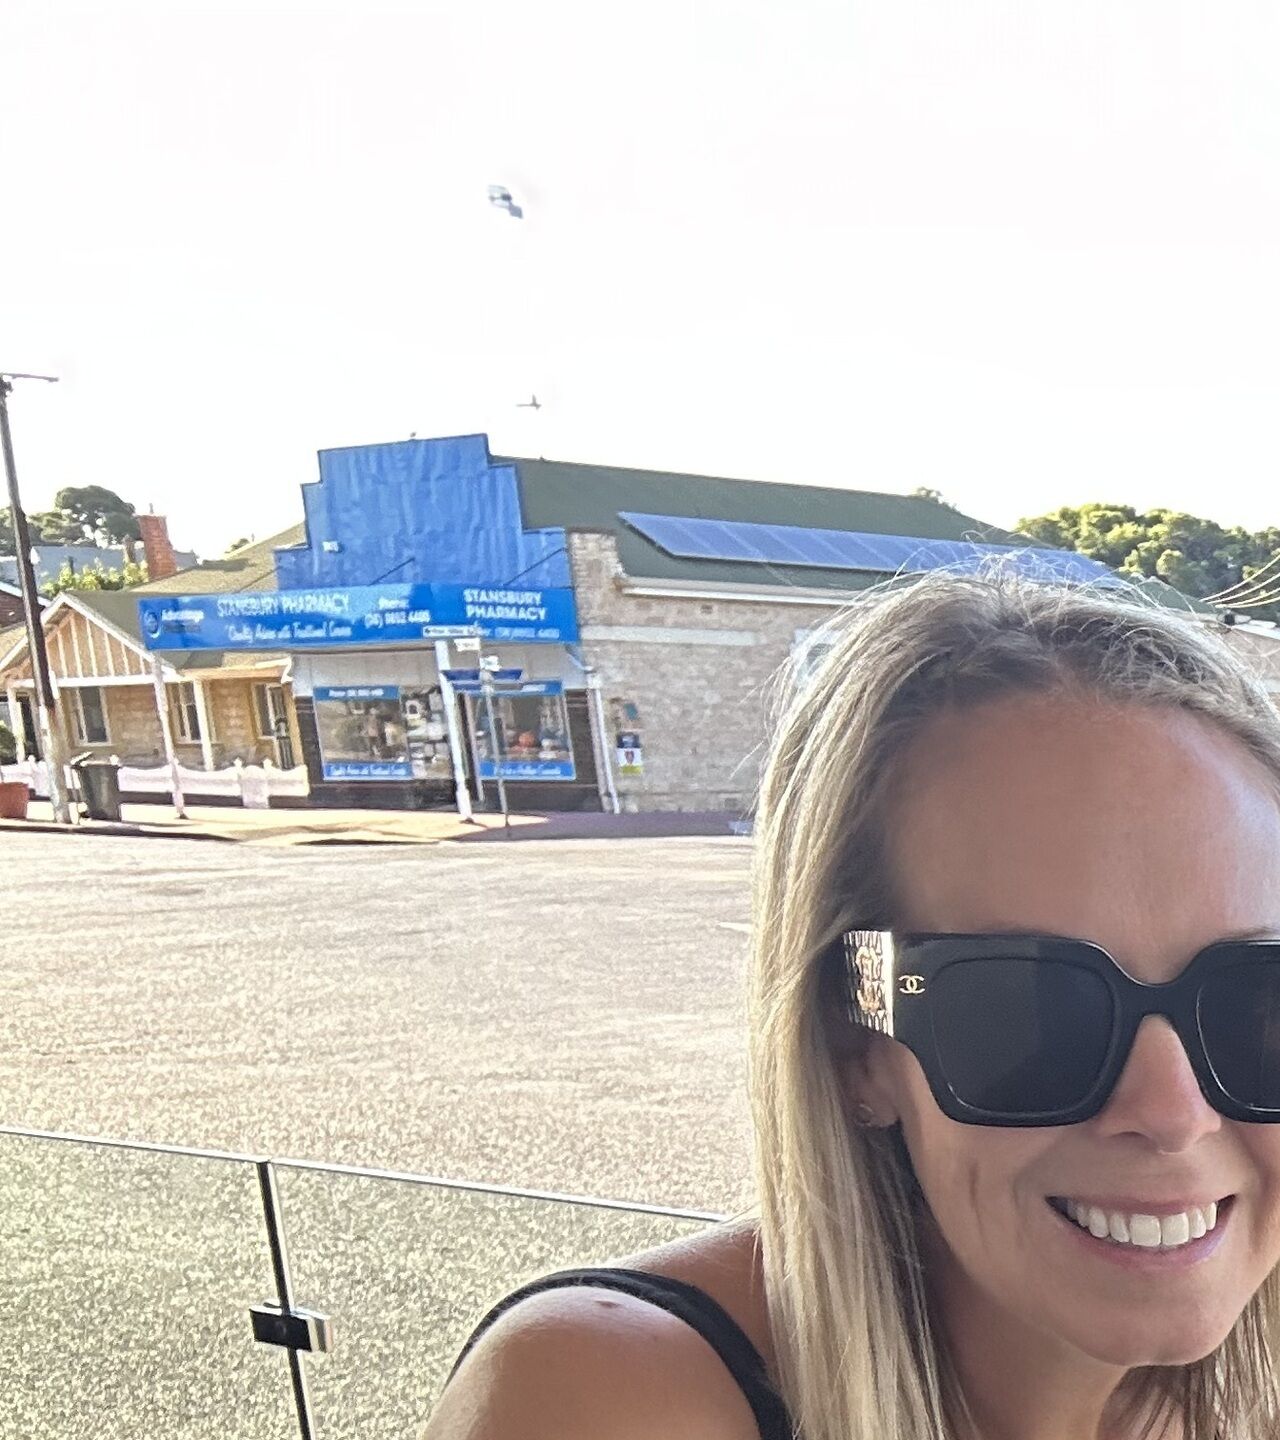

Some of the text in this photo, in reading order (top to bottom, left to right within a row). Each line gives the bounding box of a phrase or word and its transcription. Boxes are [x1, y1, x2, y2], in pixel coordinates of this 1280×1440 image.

[217, 592, 350, 617] STANSBURY PHARMACY
[463, 588, 541, 605] STANSBURY
[466, 604, 546, 621] PHARMACY
